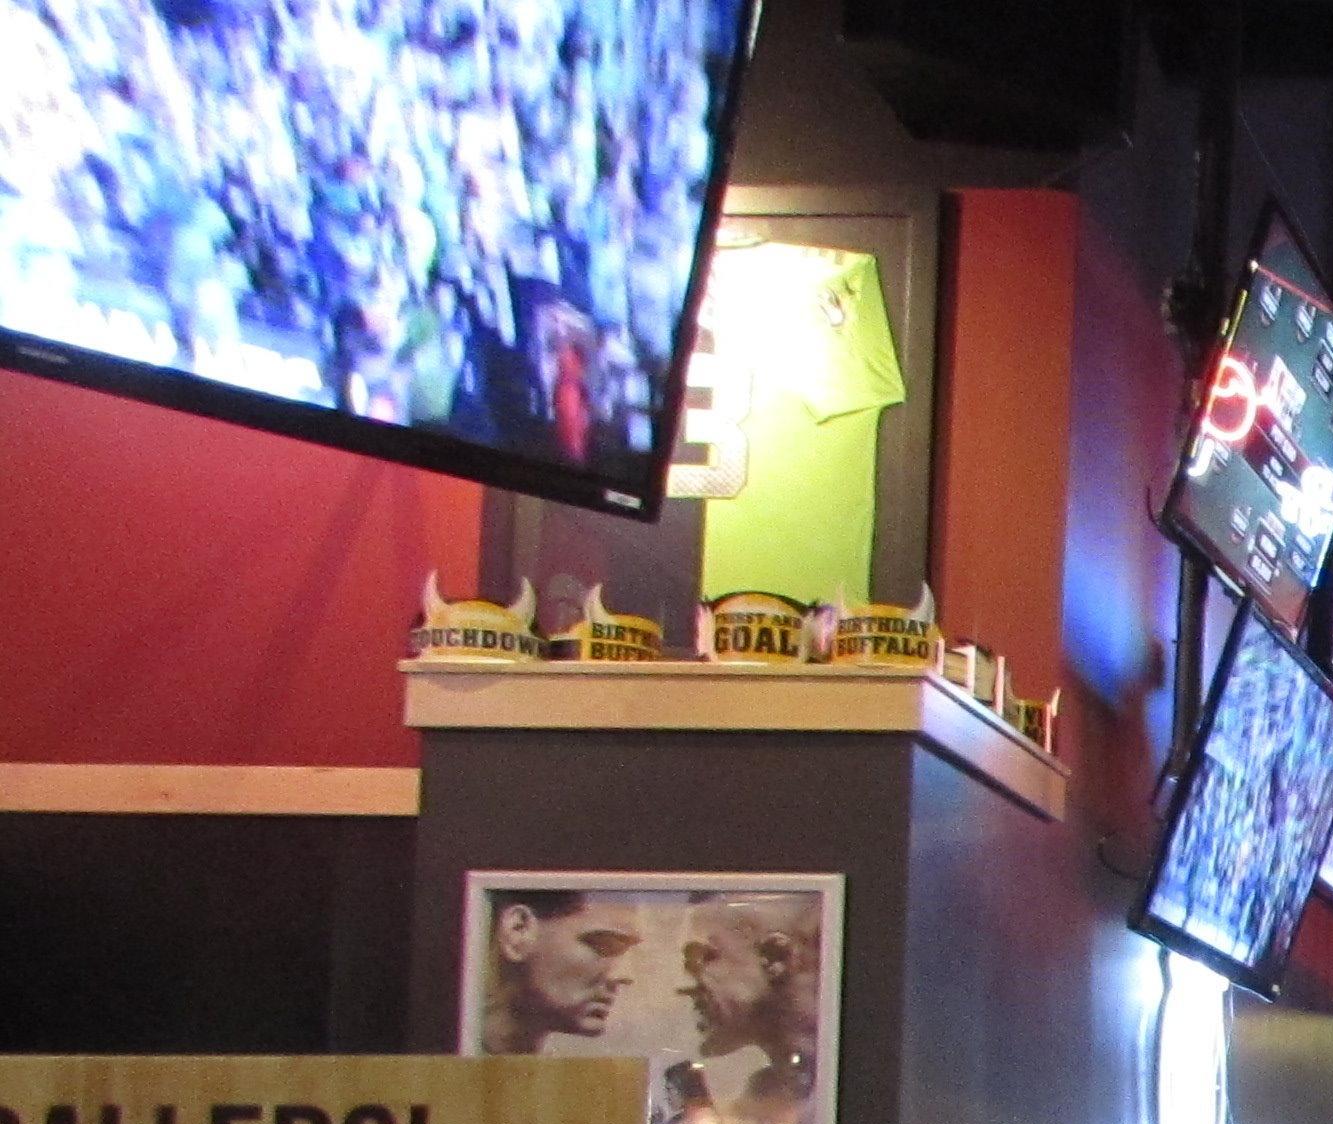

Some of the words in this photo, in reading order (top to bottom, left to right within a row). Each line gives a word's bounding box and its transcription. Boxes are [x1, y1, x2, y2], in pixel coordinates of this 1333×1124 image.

[838, 616, 931, 638] BIRTHDAY
[714, 625, 799, 657] GOAL
[836, 635, 931, 660] BUFFALO
